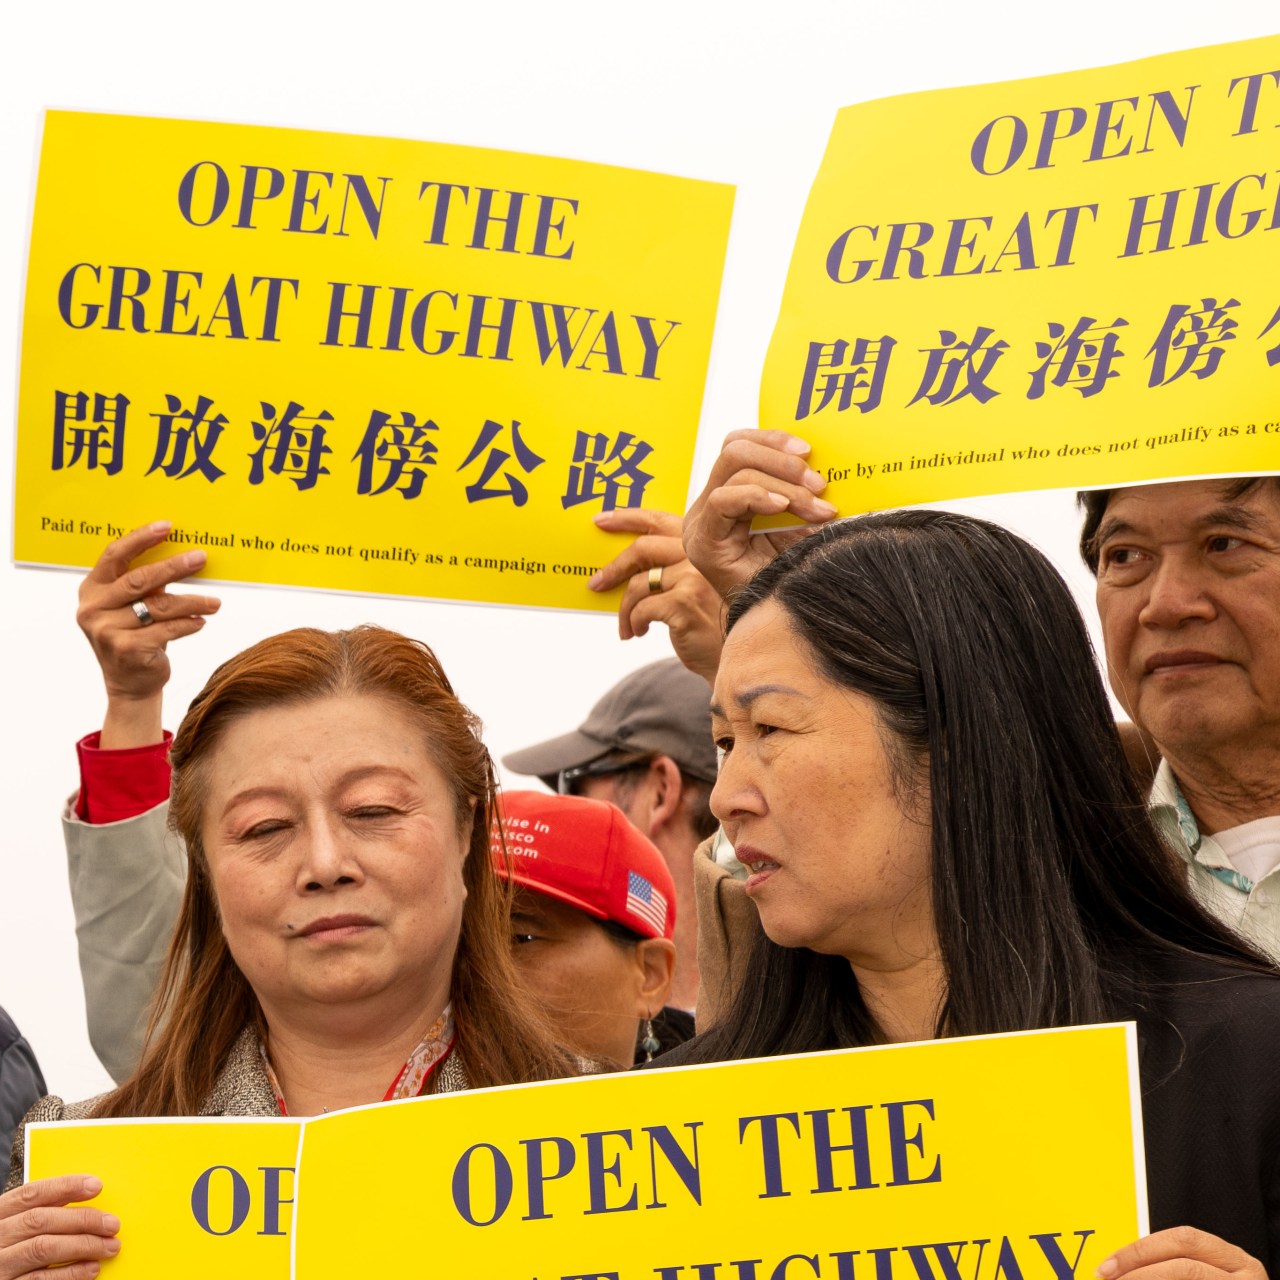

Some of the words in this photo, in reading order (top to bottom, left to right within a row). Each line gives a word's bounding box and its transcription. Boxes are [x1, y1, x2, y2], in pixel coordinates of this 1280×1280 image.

[971, 86, 1198, 175] OPEN
[178, 162, 392, 239] OPEN
[420, 182, 578, 259] THE
[827, 204, 1098, 283] GREAT
[58, 263, 299, 341] GREAT
[320, 283, 680, 379] HIGHWAY
[52, 390, 654, 511] 開放海傍公路
[827, 468, 850, 483] for
[857, 463, 873, 478] by
[882, 462, 902, 473] an
[911, 449, 1004, 469] individual
[1013, 447, 1050, 459] who
[1057, 445, 1100, 456] does
[1109, 439, 1137, 452] not
[1146, 427, 1208, 449] qualify
[1219, 427, 1239, 437] as
[1246, 425, 1255, 434] a
[42, 517, 73, 533] Paid
[80, 521, 102, 535] for
[107, 523, 124, 540] by
[241, 536, 274, 550] who
[281, 539, 319, 552] does
[326, 545, 352, 556] not
[360, 547, 417, 565] qualify
[425, 554, 443, 564] as
[449, 556, 458, 565] a
[464, 557, 545, 574] campaign
[534, 820, 550, 834] in
[452, 1122, 703, 1226] OPEN
[739, 1099, 941, 1198] THE
